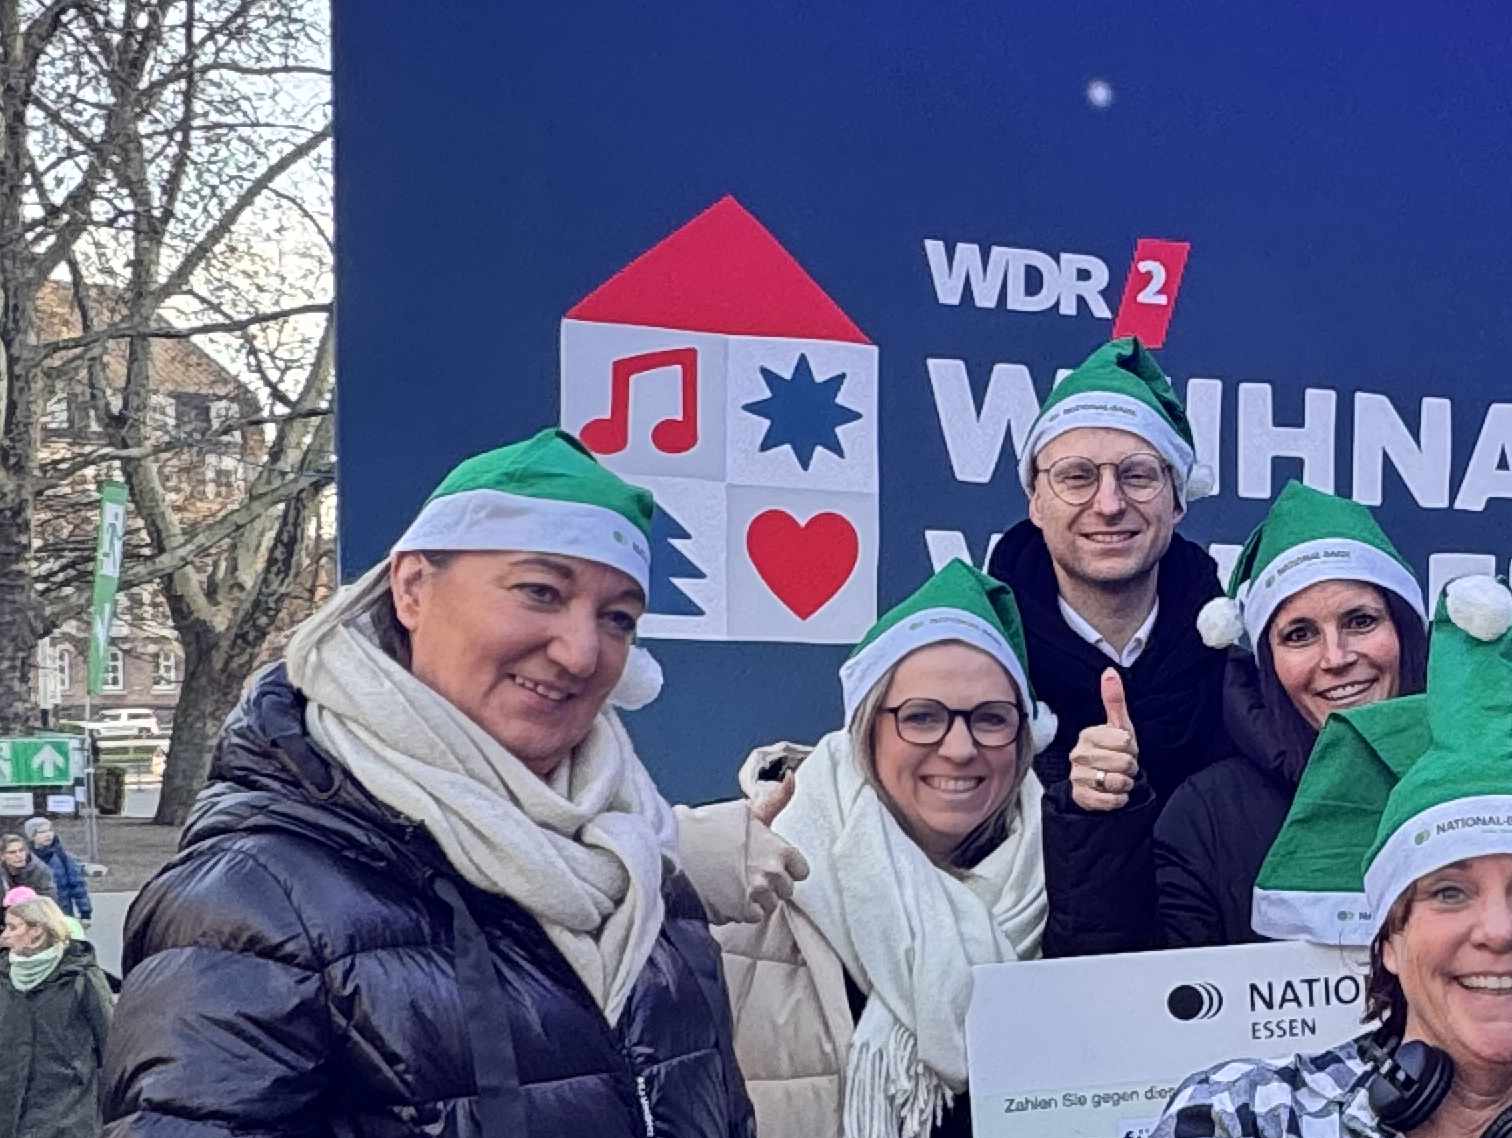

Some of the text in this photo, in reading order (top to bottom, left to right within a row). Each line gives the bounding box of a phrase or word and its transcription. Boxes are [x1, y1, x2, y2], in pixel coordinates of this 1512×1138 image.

[924, 239, 1169, 319] WDR 2
[1249, 974, 1368, 1012] NATIO
[1251, 1017, 1317, 1040] ESSEN
